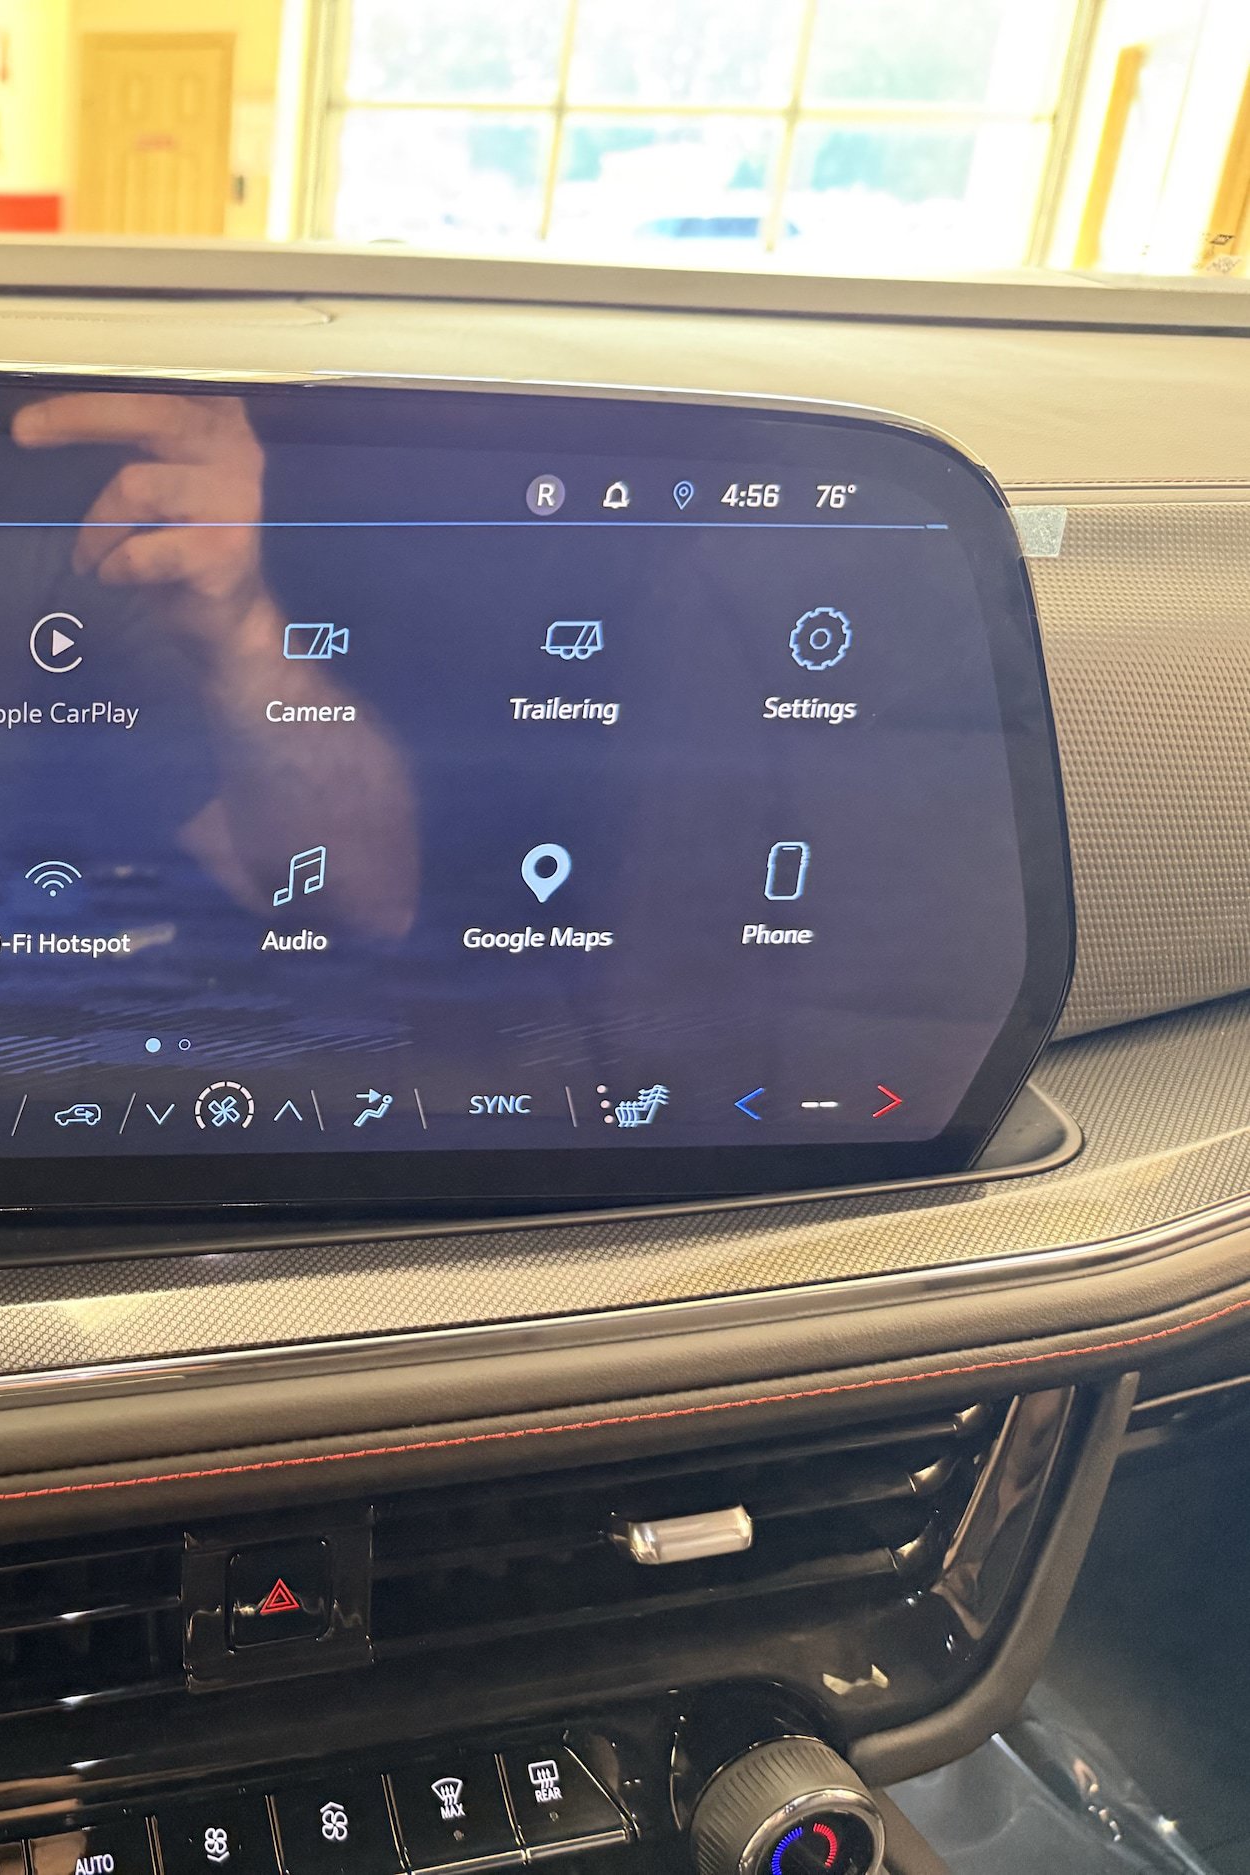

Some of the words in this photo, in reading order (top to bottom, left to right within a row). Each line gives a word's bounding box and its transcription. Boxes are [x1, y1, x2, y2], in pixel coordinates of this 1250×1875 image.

[537, 482, 556, 507] R
[720, 482, 781, 508] 4:56
[815, 483, 857, 509] 76°
[49, 701, 139, 729] CarPlay
[265, 700, 356, 723] Camera
[509, 696, 619, 726] Trailering
[762, 696, 857, 725] Settings
[38, 932, 131, 959] Hotspot
[261, 929, 328, 951] Audio
[462, 925, 546, 953] Google
[549, 926, 614, 952] Maps
[740, 922, 814, 945] Phone
[467, 1093, 533, 1115] SYNC
[533, 1786, 563, 1804] REAR
[439, 1802, 466, 1820] MAX
[74, 1853, 115, 1875] AUTO
